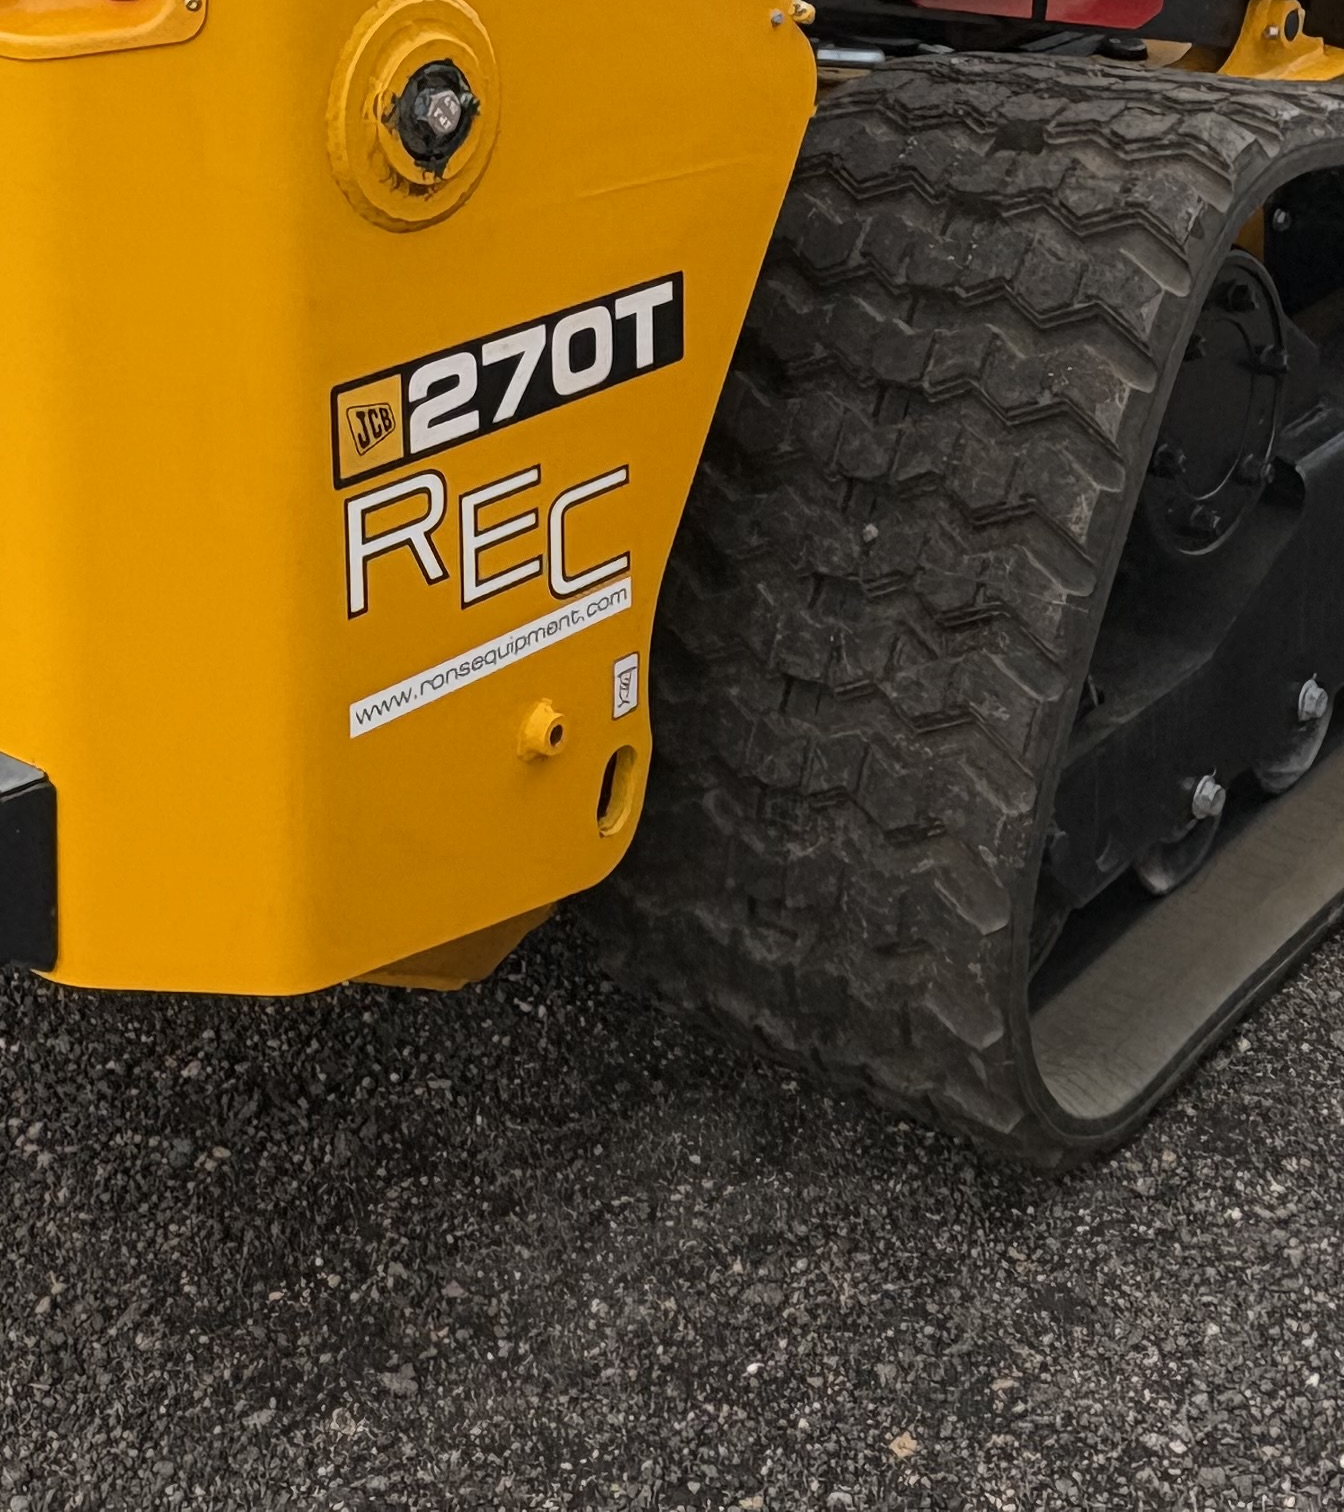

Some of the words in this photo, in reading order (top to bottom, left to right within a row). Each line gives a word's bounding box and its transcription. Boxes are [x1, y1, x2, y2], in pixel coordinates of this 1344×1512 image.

[355, 407, 394, 449] JCB
[409, 281, 673, 454] 270T
[344, 464, 630, 619] REC
[354, 586, 629, 725] www.ronsequipment.com
